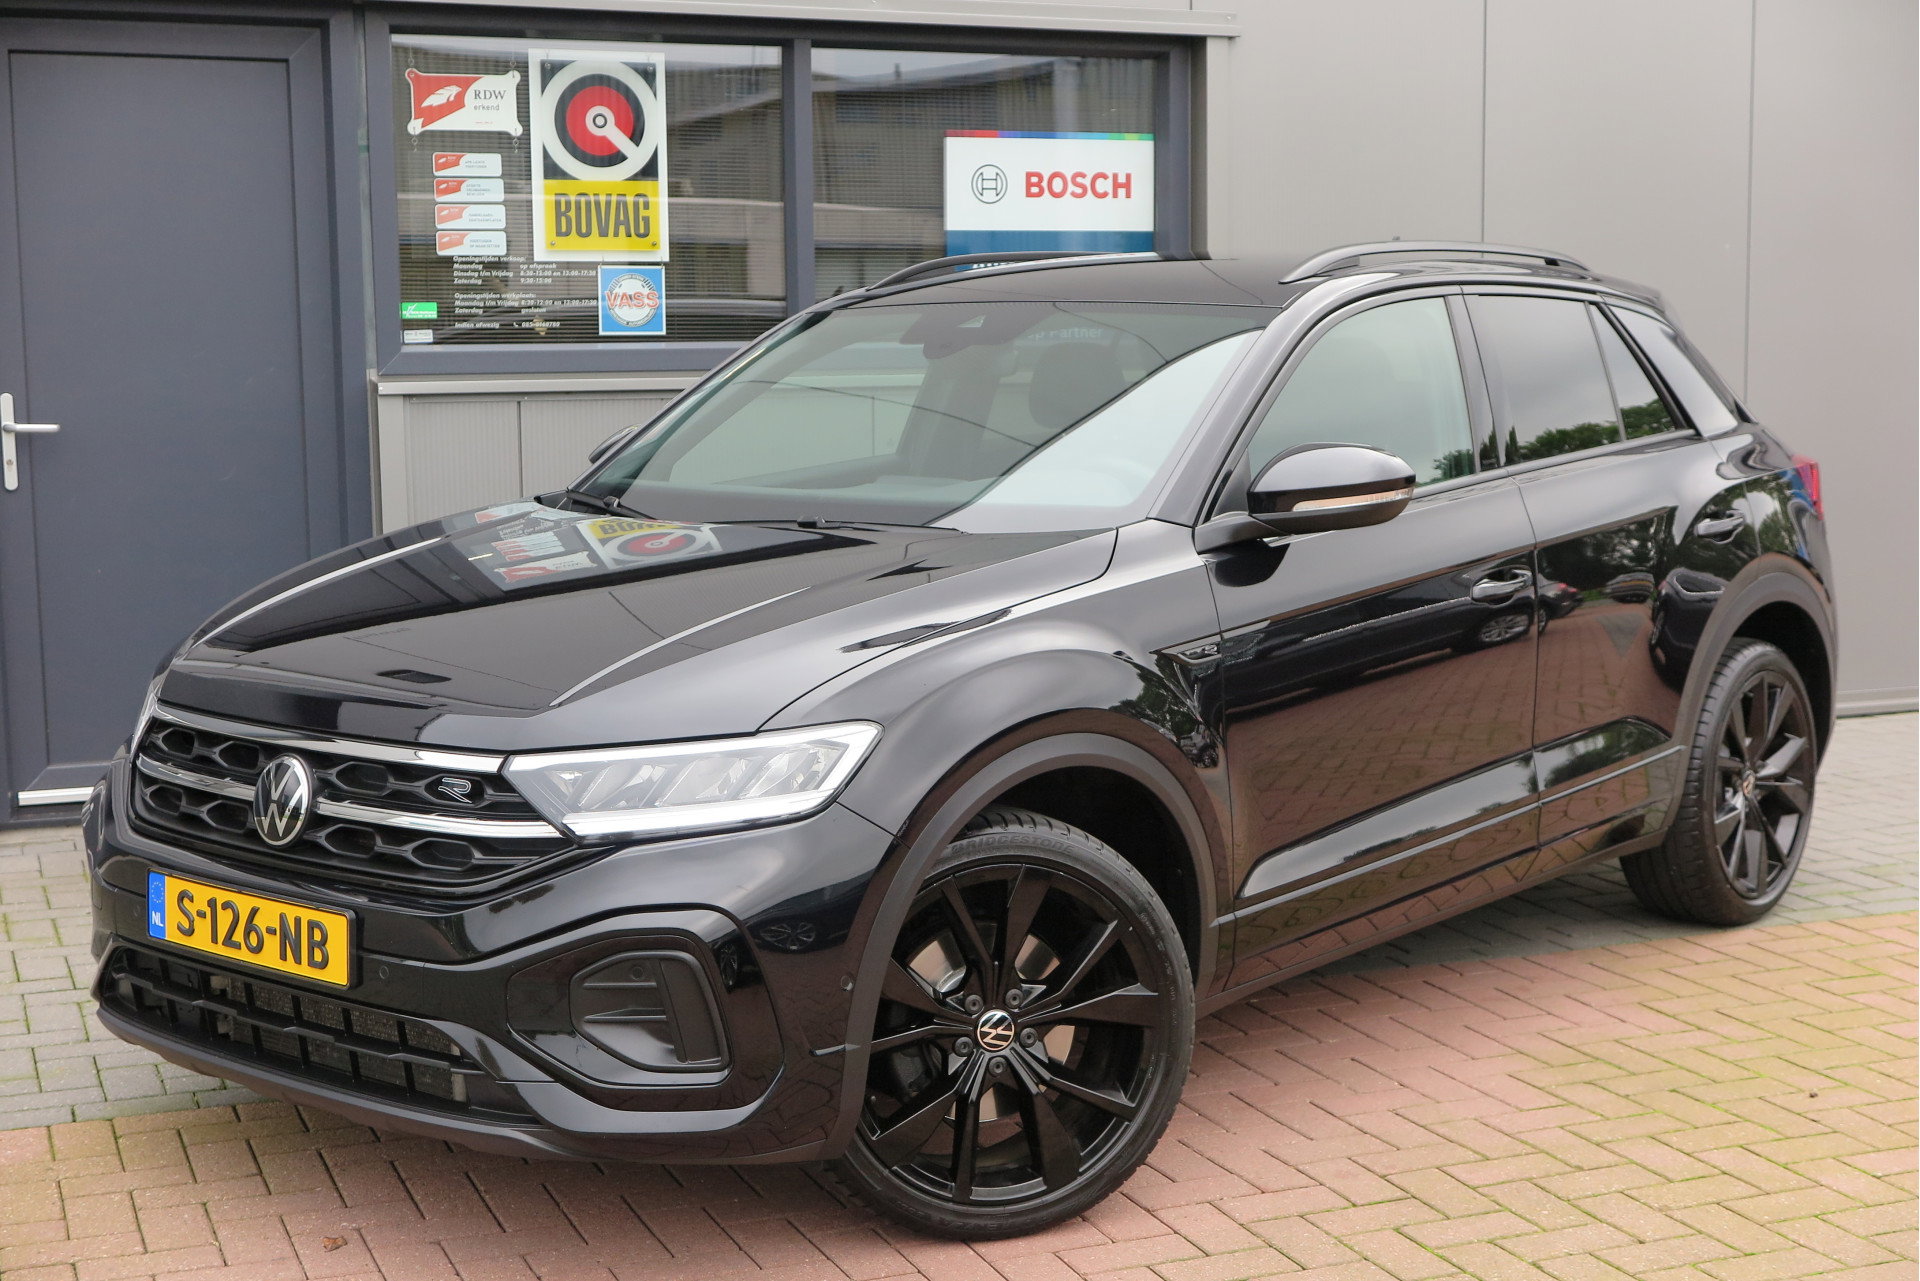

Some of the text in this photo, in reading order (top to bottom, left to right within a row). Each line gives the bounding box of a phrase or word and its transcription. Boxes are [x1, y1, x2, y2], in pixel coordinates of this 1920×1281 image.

[473, 89, 506, 100] RDW
[1025, 171, 1132, 199] BOSCH
[554, 193, 650, 238] BOVAG
[453, 255, 499, 263] Openingstijden
[454, 292, 500, 300] Openingstijden
[605, 290, 660, 308] VASS
[497, 300, 519, 308] Vrijdag
[454, 307, 483, 315] Zaterdag
[475, 321, 500, 329] afwezig
[151, 910, 164, 928] NL
[176, 889, 329, 970] S-126-NB
